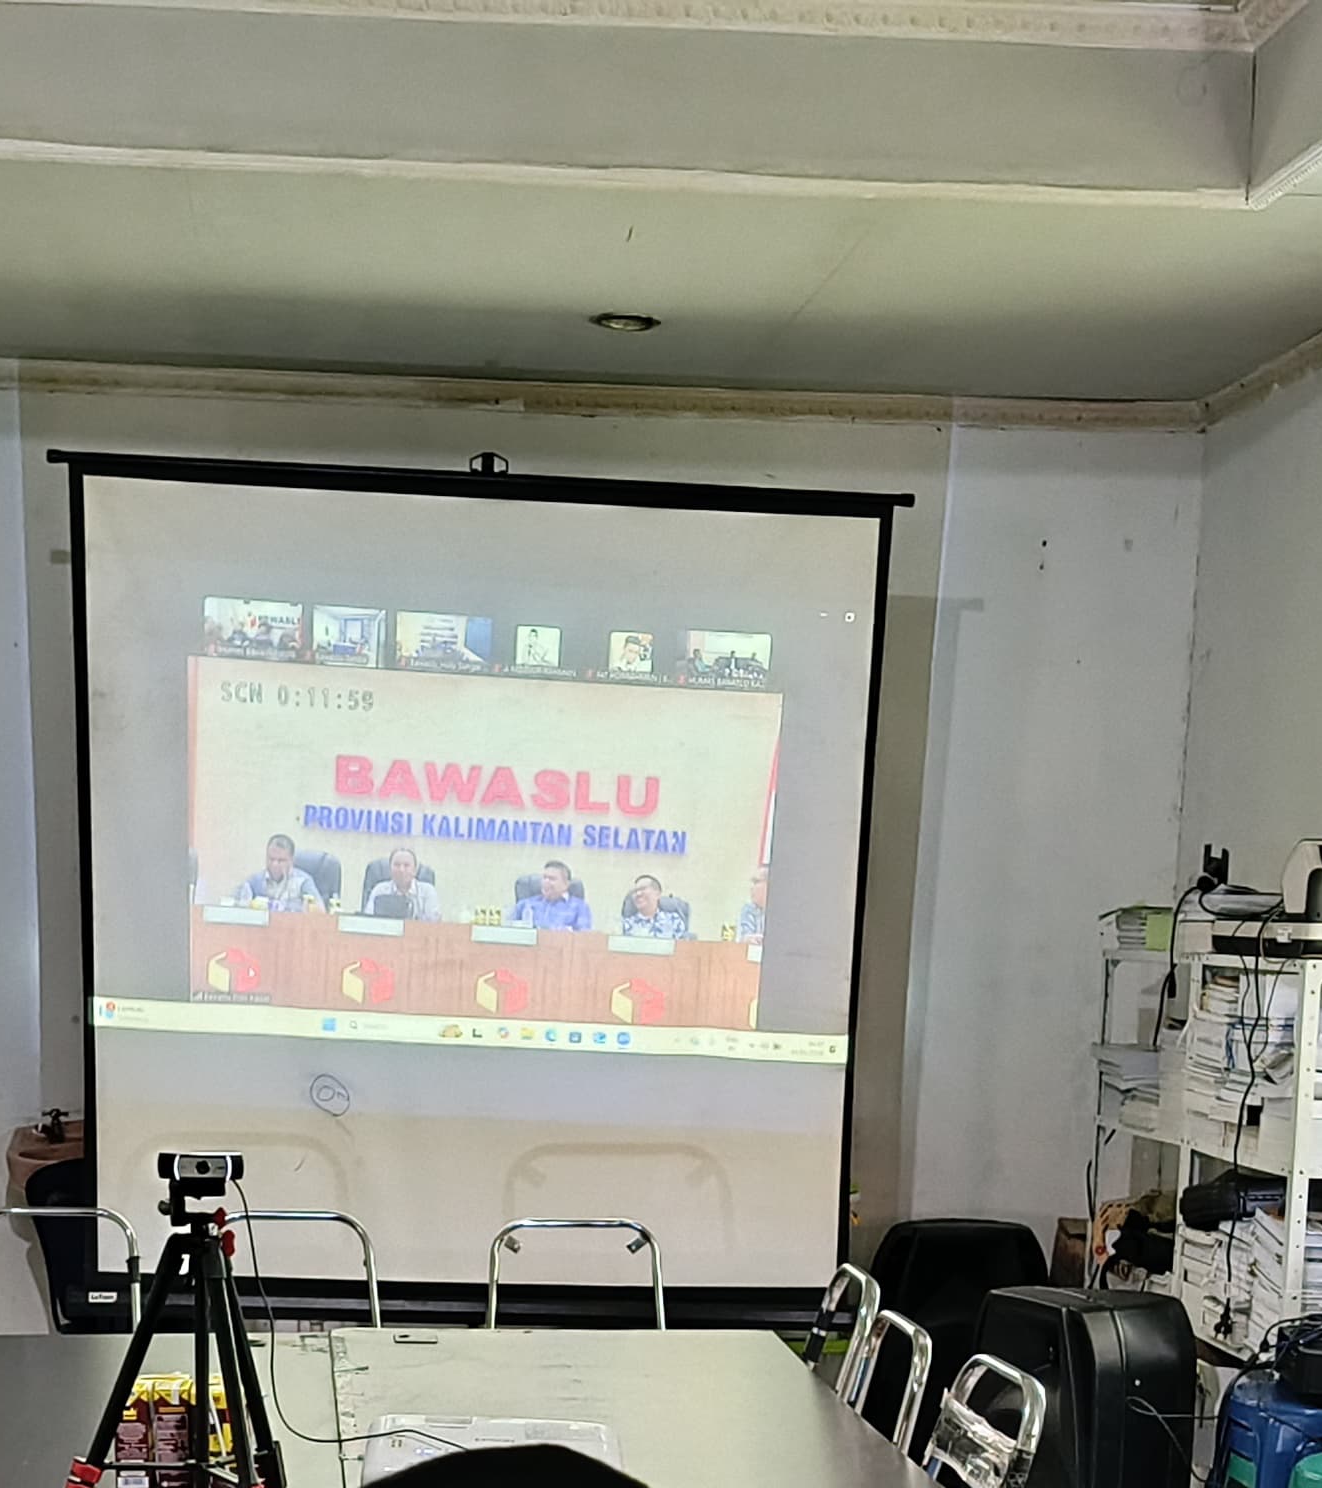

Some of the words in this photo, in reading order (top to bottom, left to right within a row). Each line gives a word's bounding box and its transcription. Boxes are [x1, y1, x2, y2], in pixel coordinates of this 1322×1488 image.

[276, 684, 374, 712] 0:11:59
[334, 754, 661, 818] BAWASLU
[304, 804, 413, 836] PROVINSI
[422, 813, 573, 849] KALIMANTAN
[582, 824, 688, 856] SELATAN
